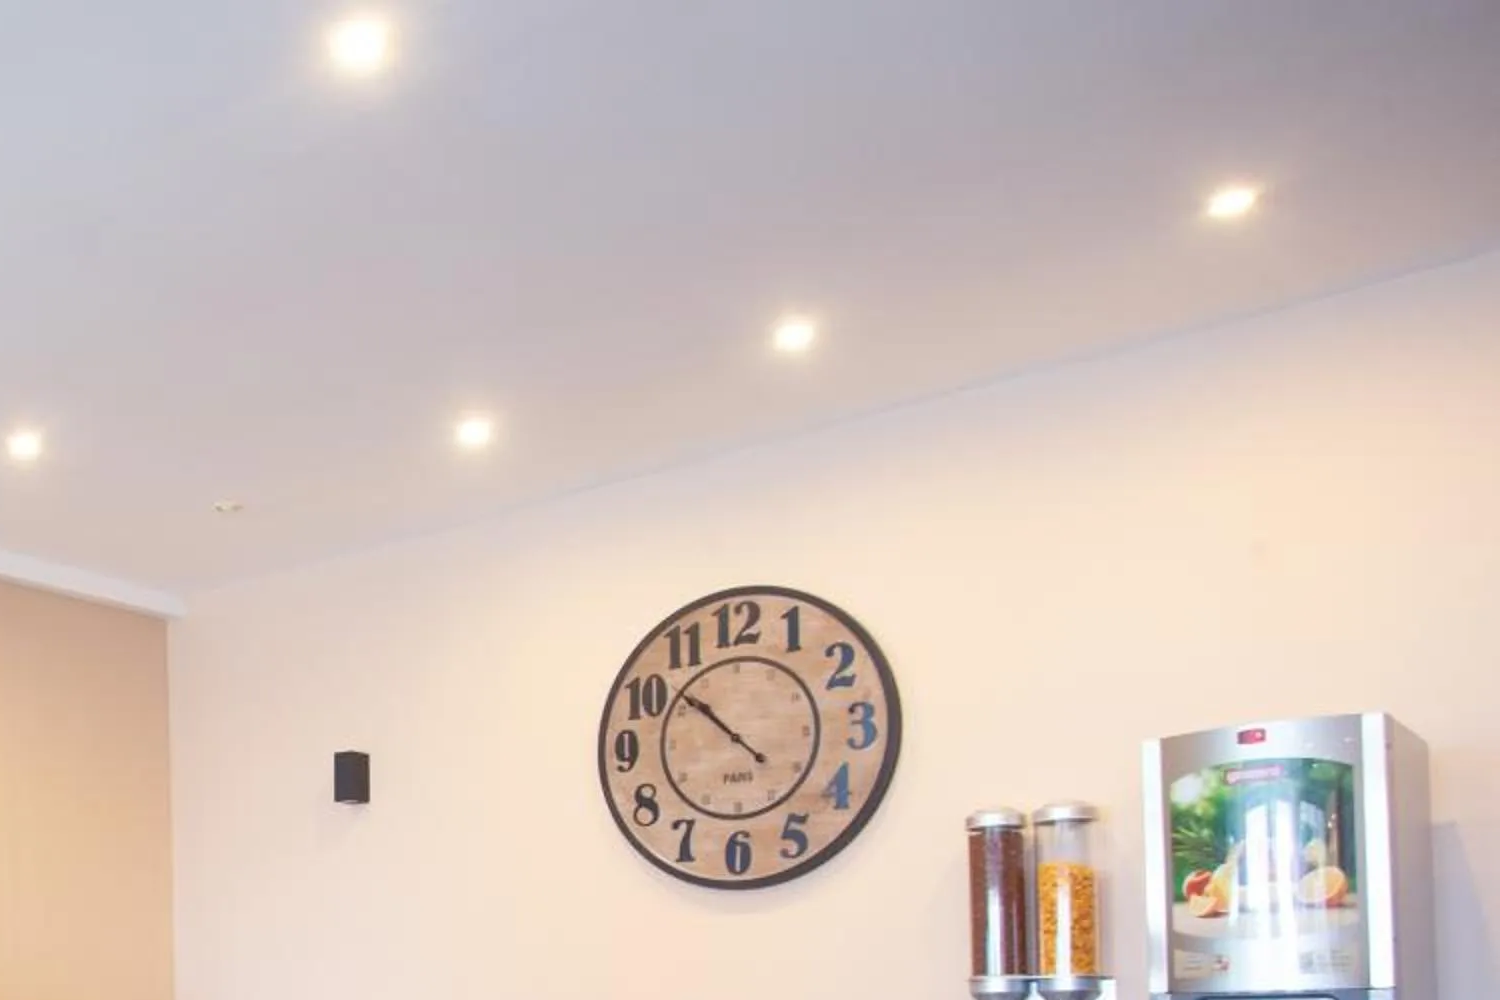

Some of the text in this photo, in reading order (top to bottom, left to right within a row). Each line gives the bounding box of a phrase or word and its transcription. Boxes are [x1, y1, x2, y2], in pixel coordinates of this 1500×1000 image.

[664, 621, 702, 669] 11
[712, 601, 761, 649] 12
[781, 605, 801, 653] 1
[825, 642, 856, 690] 2
[624, 673, 668, 721] 10
[847, 702, 877, 750] 3
[615, 729, 639, 773] 9
[633, 783, 660, 827] 8
[822, 762, 853, 810] 4
[671, 819, 696, 863] 7
[725, 830, 752, 875] 6
[780, 813, 809, 858] 5
